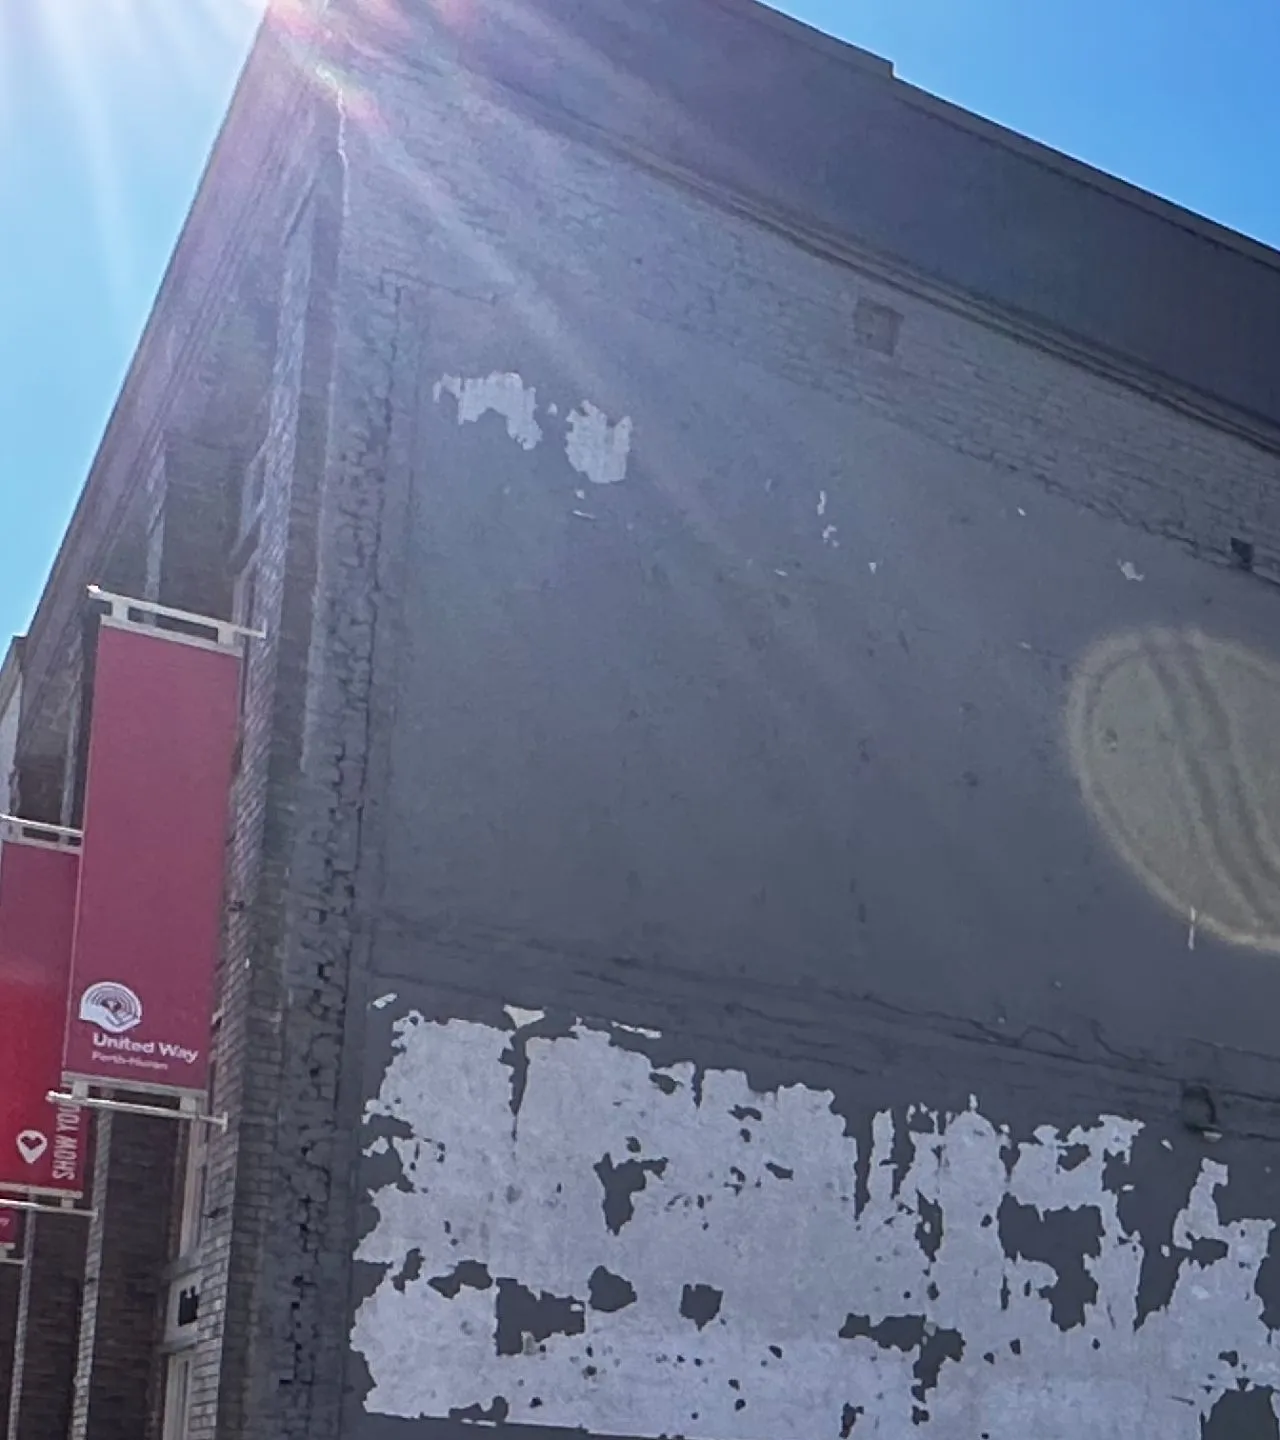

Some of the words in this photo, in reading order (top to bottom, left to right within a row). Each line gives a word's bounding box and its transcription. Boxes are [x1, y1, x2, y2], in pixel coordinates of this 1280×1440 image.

[93, 1031, 155, 1054] United
[158, 1042, 199, 1065] Way
[52, 1134, 78, 1181] SHOW
